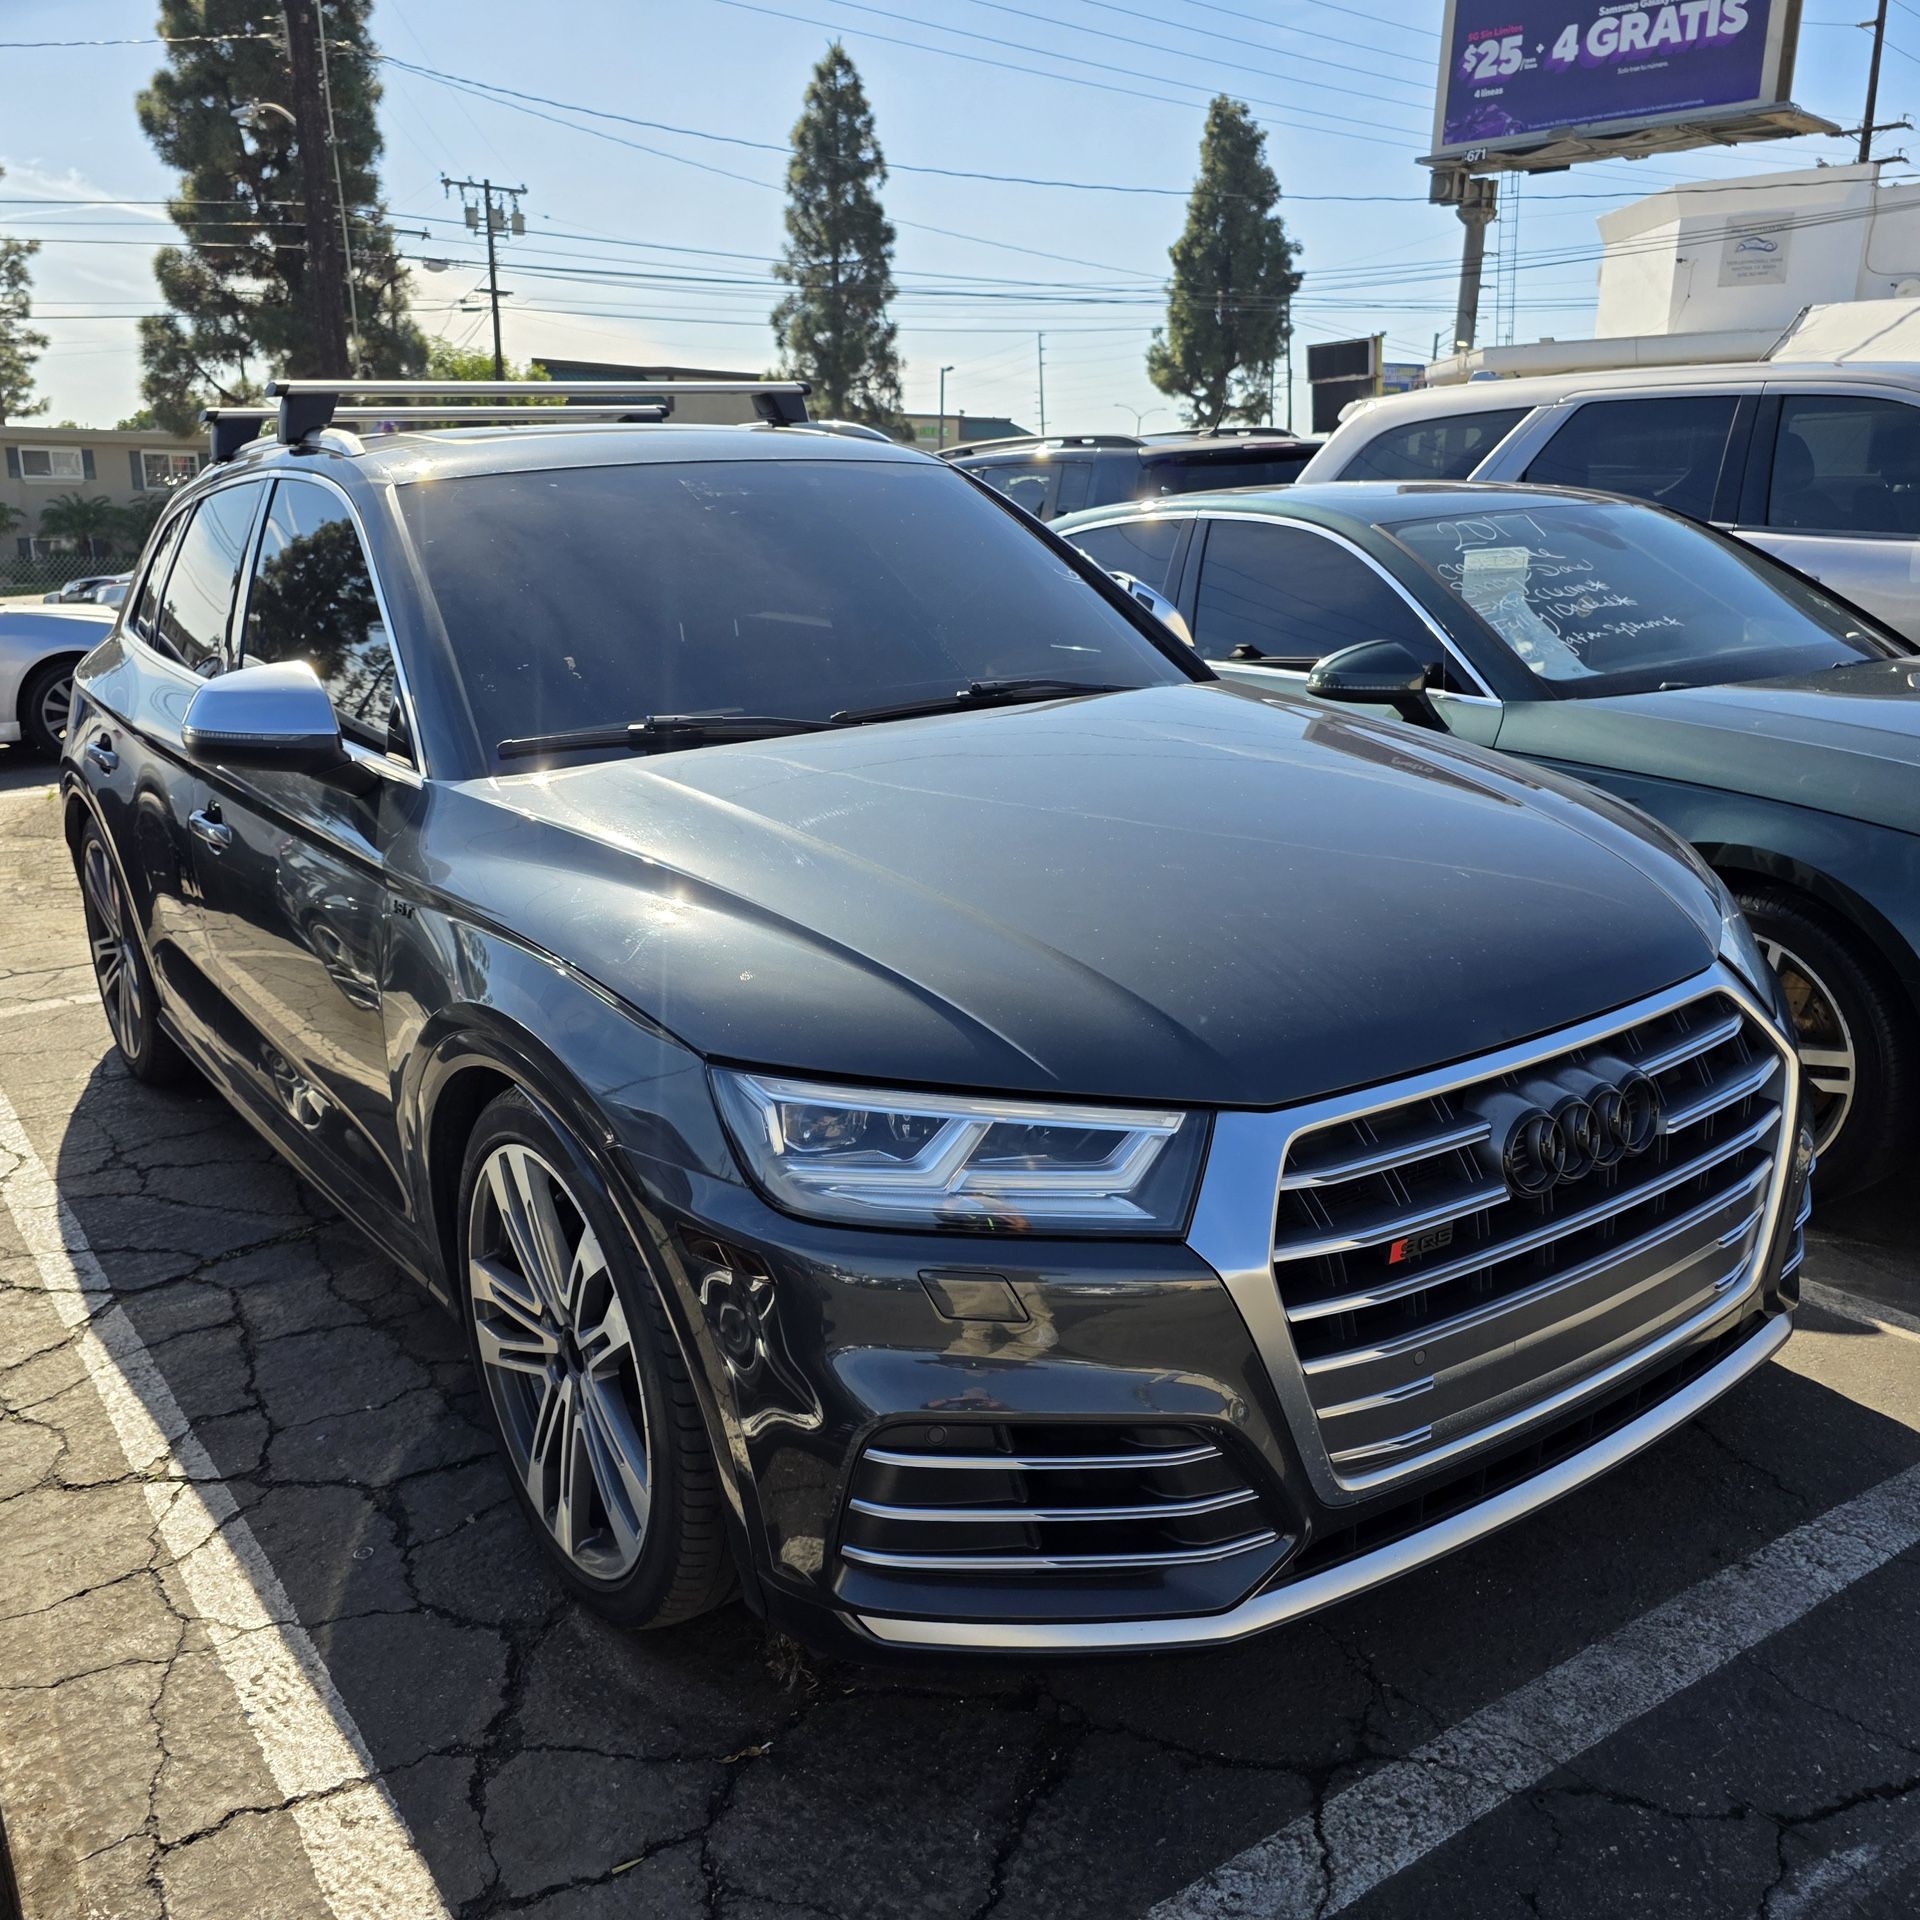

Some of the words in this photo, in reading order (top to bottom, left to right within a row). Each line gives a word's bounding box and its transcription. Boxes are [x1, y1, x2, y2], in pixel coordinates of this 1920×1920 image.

[1599, 3, 1640, 16] Samsung
[1462, 34, 1523, 80] $25
[1552, 23, 1579, 62] 4
[1586, 0, 1749, 57] GRATIS
